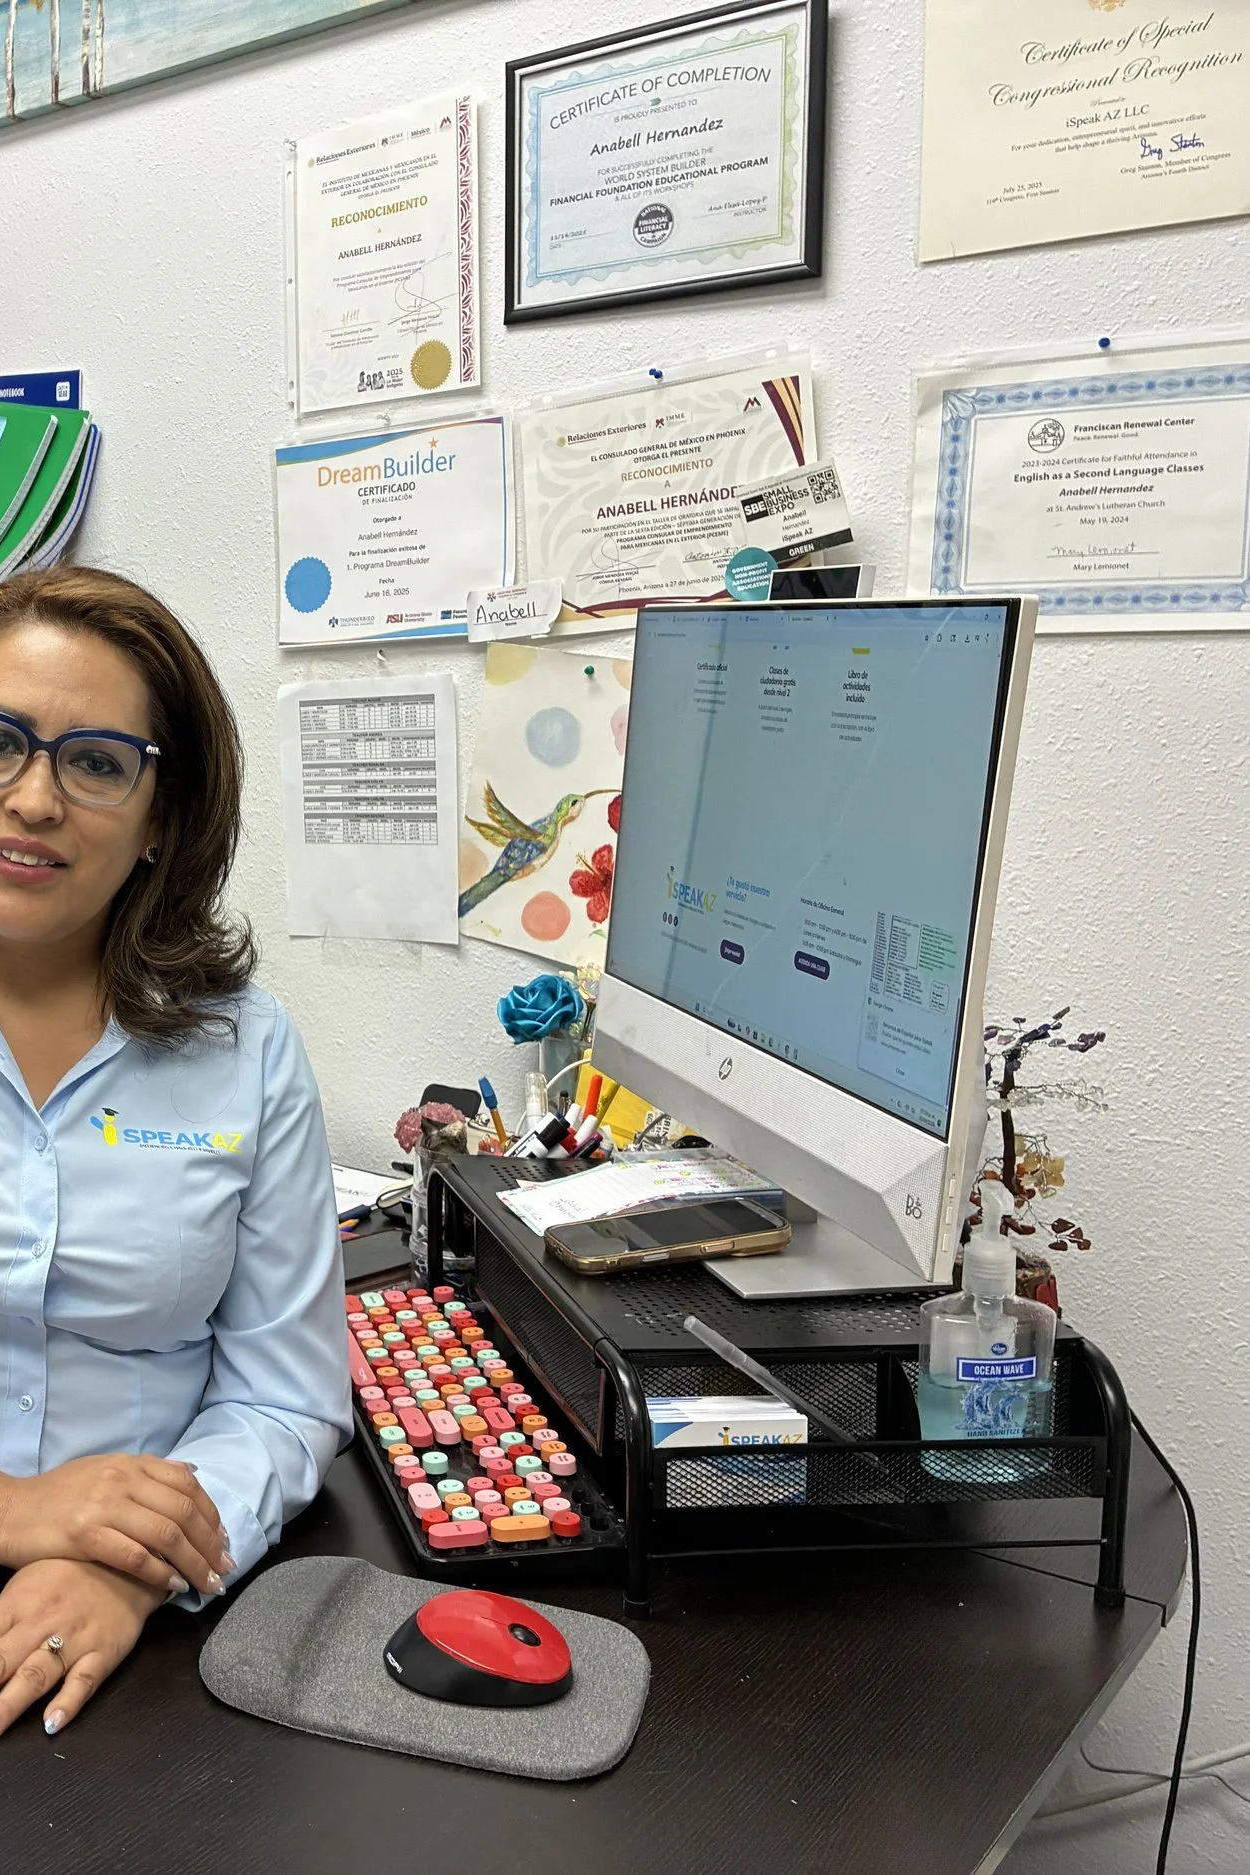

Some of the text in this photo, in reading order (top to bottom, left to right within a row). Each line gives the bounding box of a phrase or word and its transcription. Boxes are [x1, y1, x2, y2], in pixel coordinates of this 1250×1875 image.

[1020, 12, 1214, 66] Certificate of Special
[988, 51, 1243, 109] Congressional Recognition
[550, 67, 771, 130] CERTIFICATE OF COMPLETION
[1066, 104, 1149, 128] iSpeak AZ LLC
[589, 118, 723, 156] Anabell Hernandez
[316, 143, 376, 163] Relaciones Exteriores
[604, 158, 706, 184] WORLD SYSTEM BUILDER
[550, 157, 769, 206] FINANCIAL FOUNDATION EDUCATIONAL PROGRAM
[332, 196, 428, 228] RECONOCIMIENTO
[638, 216, 668, 228] FINANCIAL
[640, 223, 666, 233] LITERACY
[338, 234, 422, 260] ANABELL HERNÁNDEZ
[386, 368, 403, 376] 2025
[0, 387, 25, 398] NOTEBOOK
[567, 422, 646, 442] Relaciones Exteriores
[1074, 418, 1195, 433] Franciscan Renewal Center
[599, 448, 638, 460] CONSULADO
[639, 443, 667, 454] GENERAL
[679, 435, 705, 447] MÉXICO
[716, 428, 746, 440] PHOENIX
[634, 454, 660, 463] OTORGA
[670, 446, 701, 458] PRESENTE
[1022, 459, 1060, 468] 2023-2024
[1062, 456, 1100, 465] Certificate
[1113, 453, 1142, 462] Faithful
[1144, 451, 1188, 460] Attendance
[318, 450, 456, 487] DreamBuilder
[621, 458, 713, 482] RECONOCIMIENTO
[1014, 473, 1050, 484] English
[1052, 472, 1064, 480] as
[1073, 468, 1111, 479] Second
[1113, 466, 1164, 477] Language
[1166, 463, 1205, 473] Classes
[358, 482, 416, 497] CERTIFICADO
[665, 480, 671, 488] A
[1059, 484, 1154, 497] Anabell Hernandez
[763, 485, 794, 500] SMALL
[766, 488, 810, 508] BUSINESS
[597, 500, 657, 519] ANABELL
[744, 501, 766, 515] SBE
[769, 502, 795, 516] EXPO
[1102, 501, 1136, 510] Lutheran
[1138, 500, 1165, 508] Church
[783, 510, 807, 522] Anabell
[616, 534, 646, 543] PROGRAMA
[647, 530, 674, 540] CONSULAR
[684, 522, 732, 534] EMPRENDIMIENTO
[782, 520, 810, 531] Hernandez
[358, 529, 418, 541] Anabell Hernández
[635, 539, 665, 548] MEXICANAS
[681, 533, 706, 541] EXTERIOR
[789, 543, 814, 556] GREEN
[354, 562, 384, 571] Programa
[386, 558, 430, 567] DreamBuilder
[1073, 562, 1129, 571] Mary Lemionet
[386, 614, 403, 624] ASU
[476, 602, 537, 623] Anabell
[848, 670, 868, 679] Libro de
[787, 689, 791, 697] 2
[974, 1364, 1024, 1375] OCEAN WAVE
